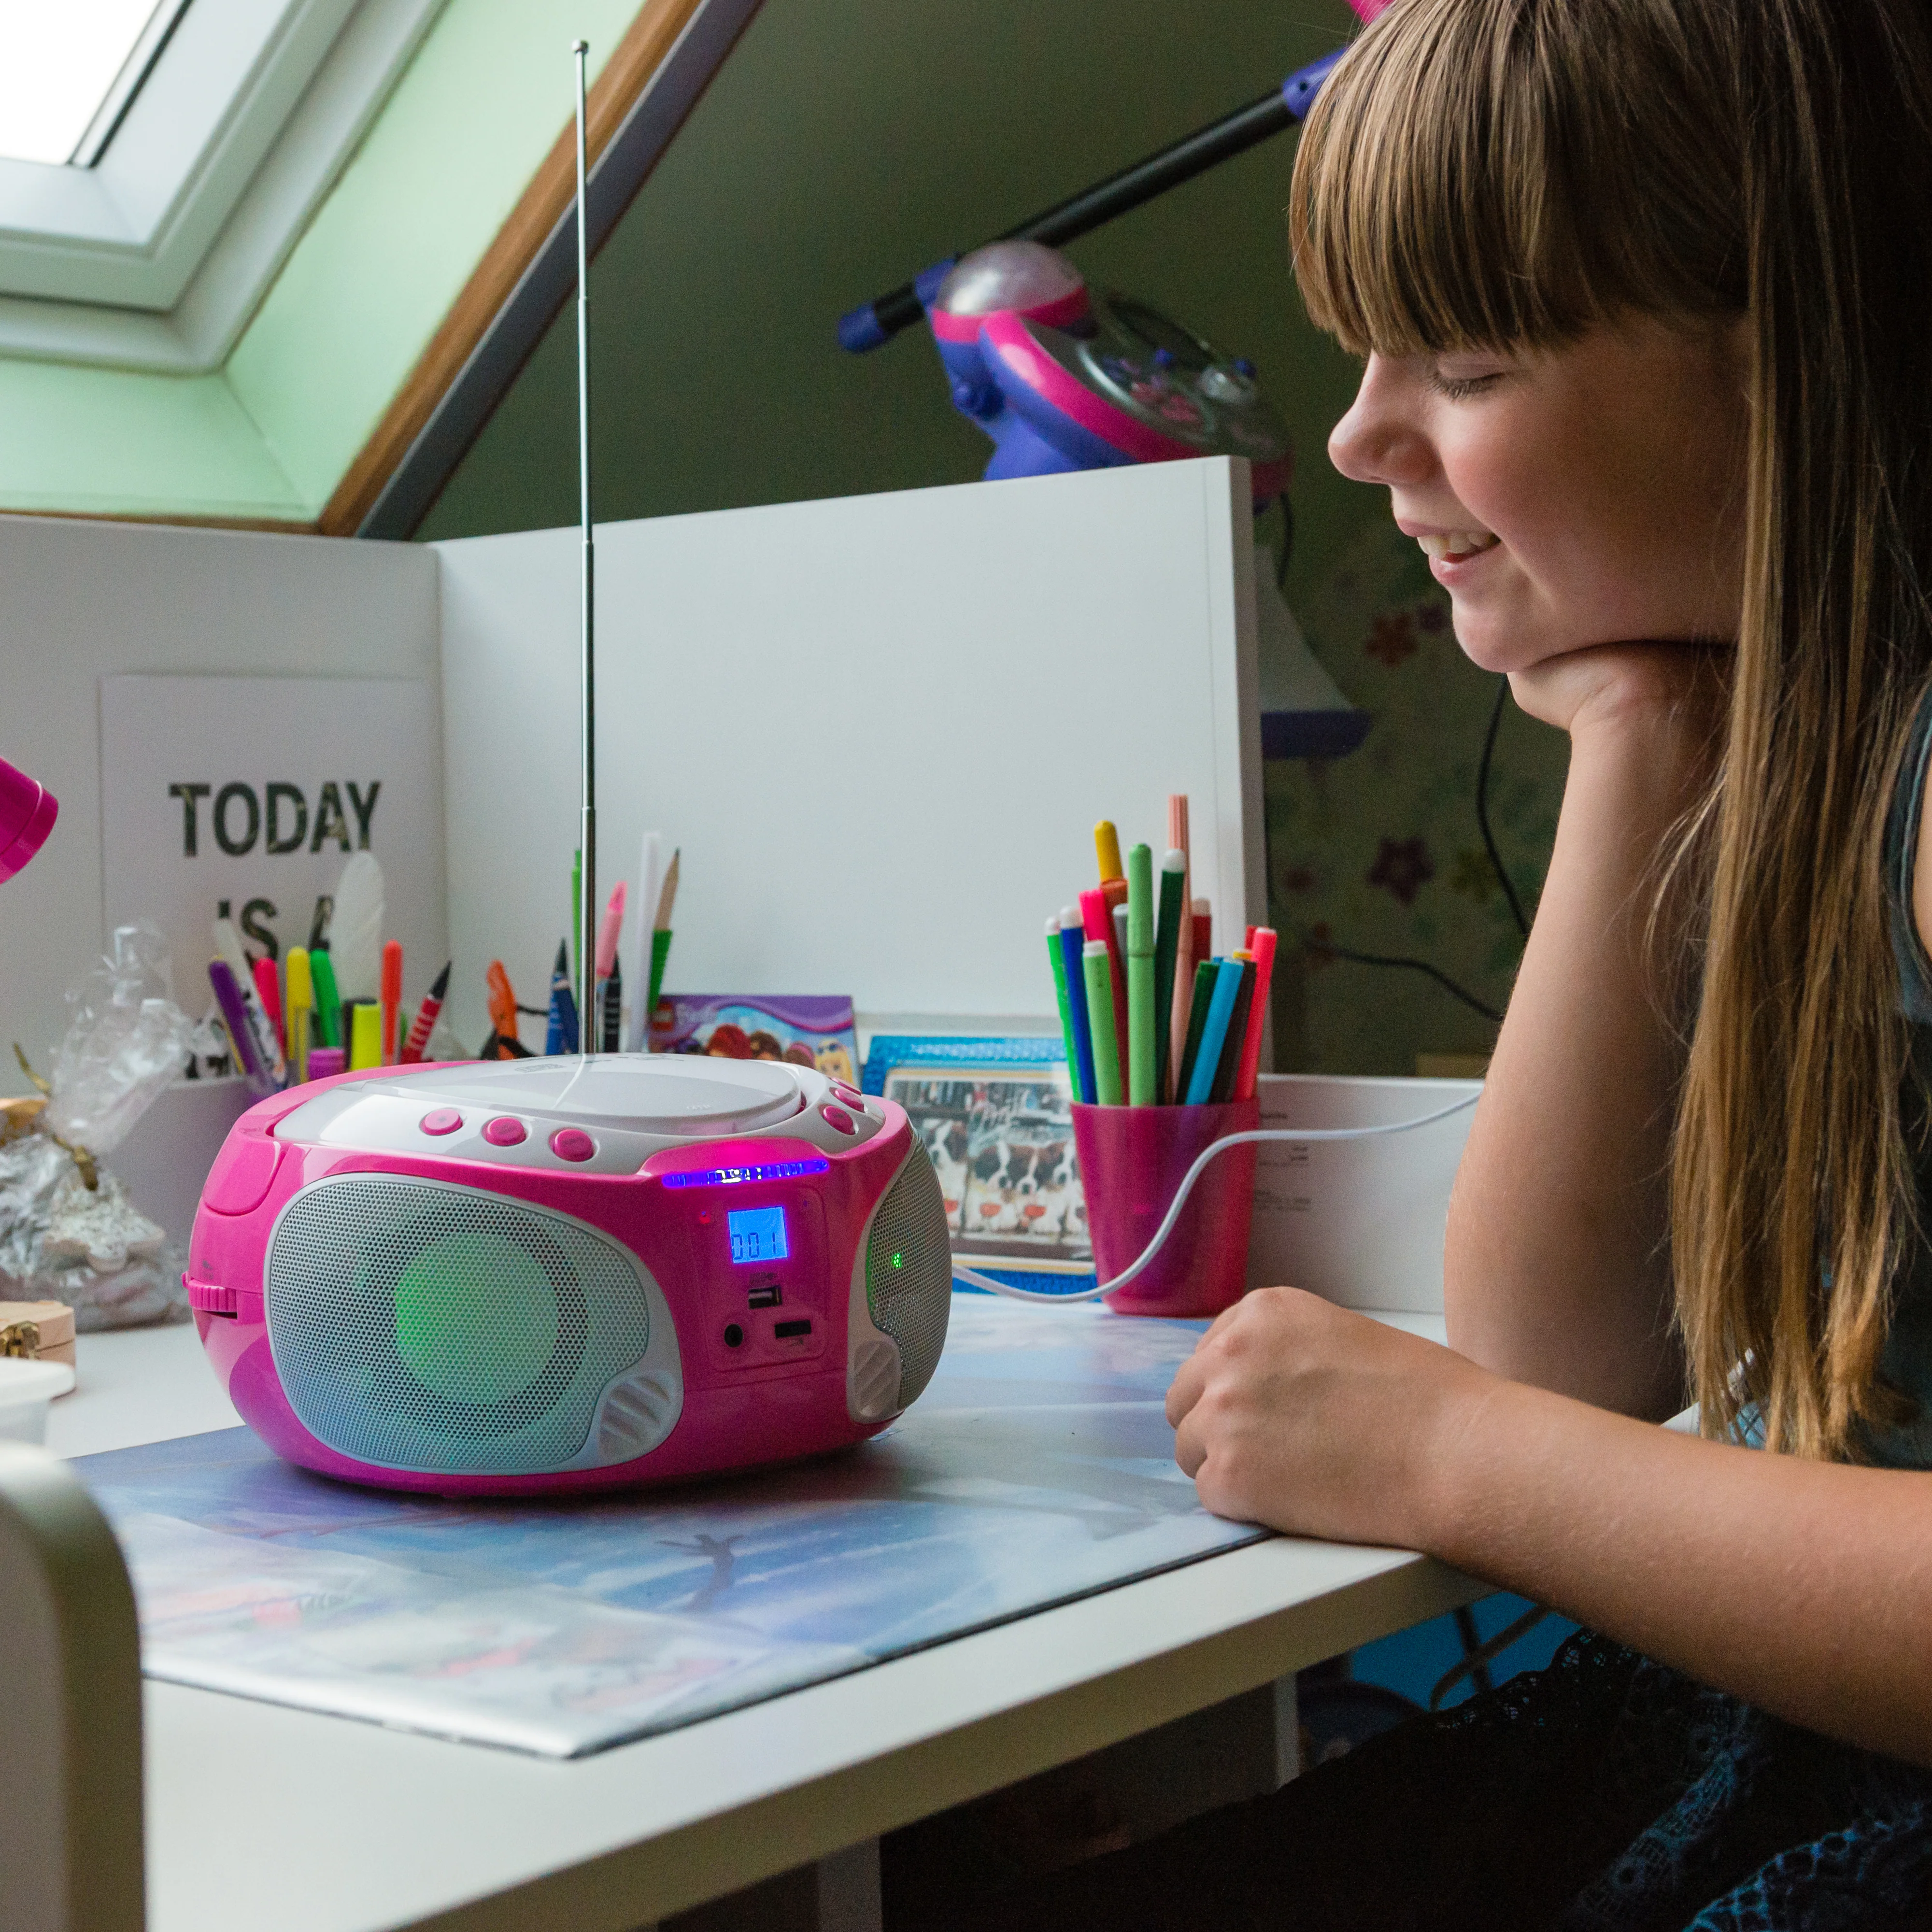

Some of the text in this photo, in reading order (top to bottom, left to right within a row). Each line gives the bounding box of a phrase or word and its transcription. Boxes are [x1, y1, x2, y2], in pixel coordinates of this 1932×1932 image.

[169, 781, 381, 857] TODAY
[218, 898, 279, 971] S
[731, 1231, 776, 1260] 001
